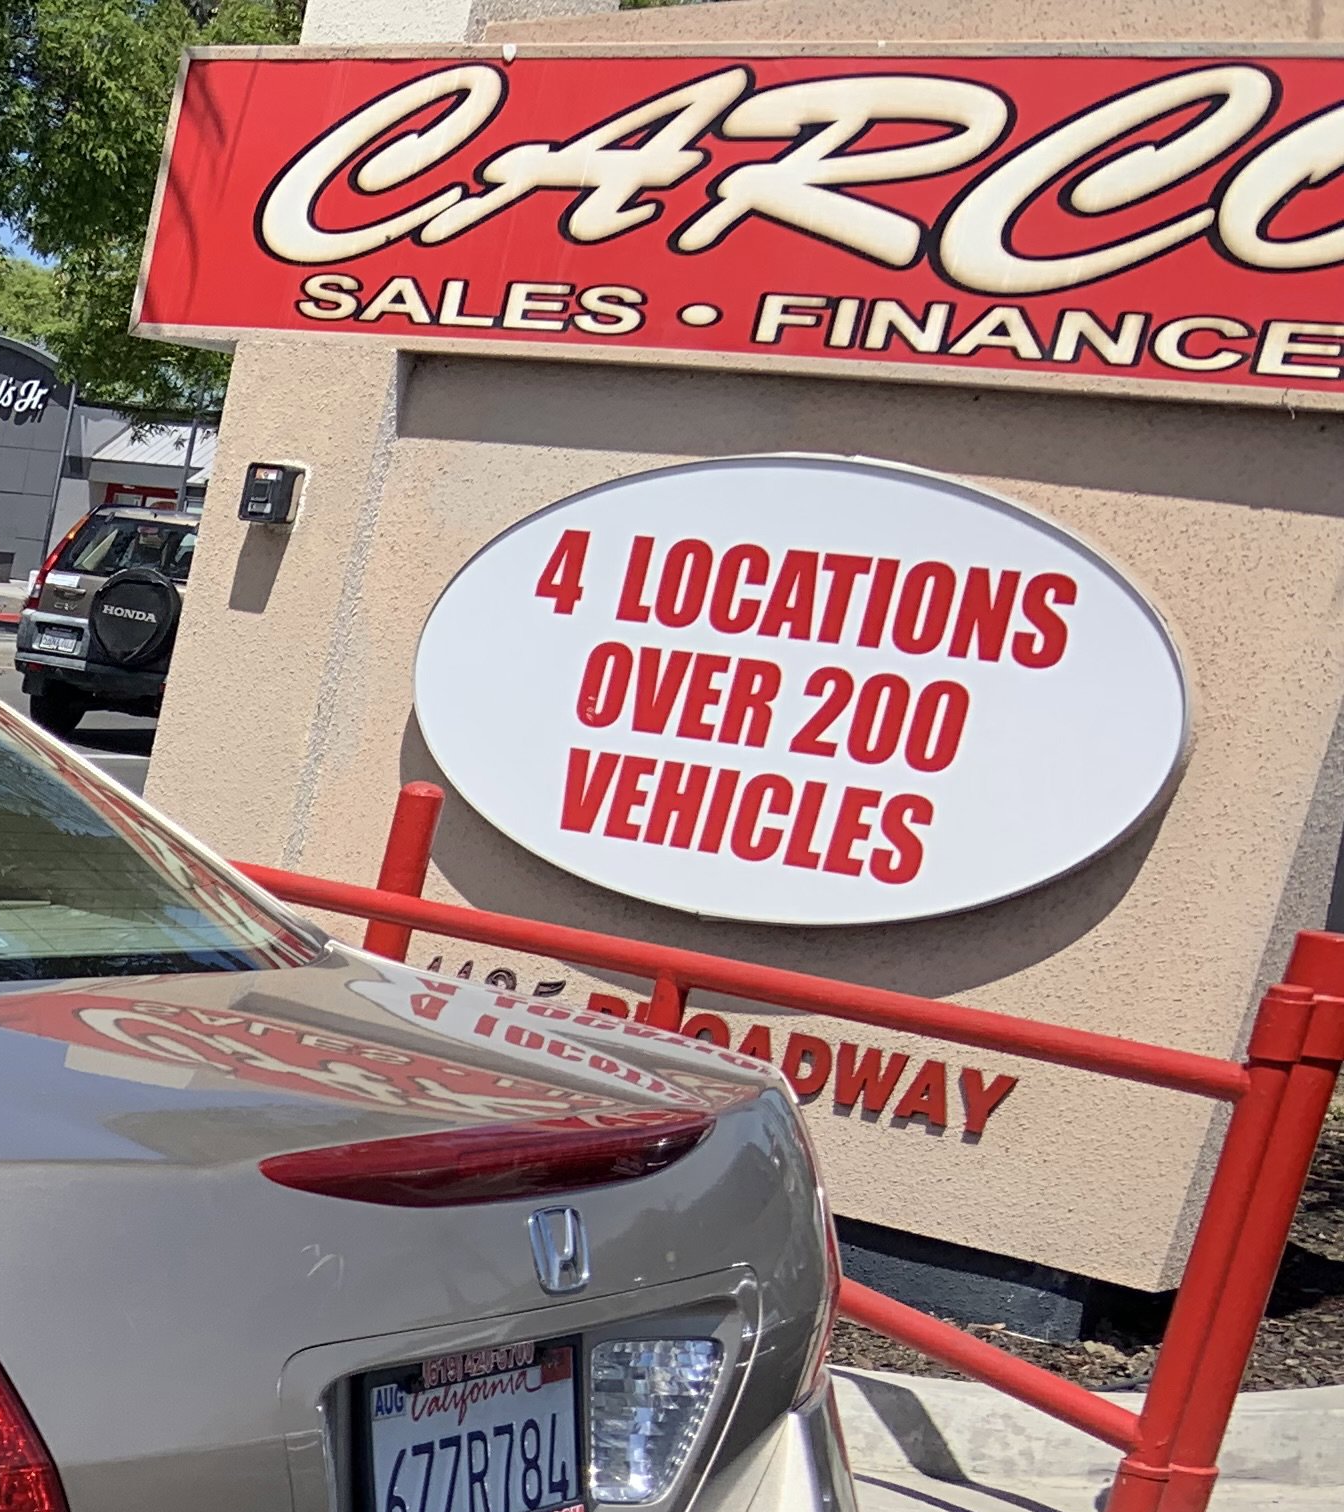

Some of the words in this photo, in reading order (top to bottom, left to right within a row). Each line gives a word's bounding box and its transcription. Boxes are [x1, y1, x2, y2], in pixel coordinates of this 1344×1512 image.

[298, 273, 645, 335] SALES
[754, 292, 1344, 379] FINANCE
[13, 379, 49, 412] Jr.
[101, 604, 158, 624] HONDA
[535, 529, 591, 615] 4
[615, 535, 1078, 669] LOCATIONS
[576, 641, 783, 748] OVER
[789, 665, 970, 773] 200
[560, 747, 935, 885] VEHICLES
[587, 992, 1018, 1135] OADWAY
[374, 1386, 405, 1417] AUG
[411, 1369, 543, 1427] California
